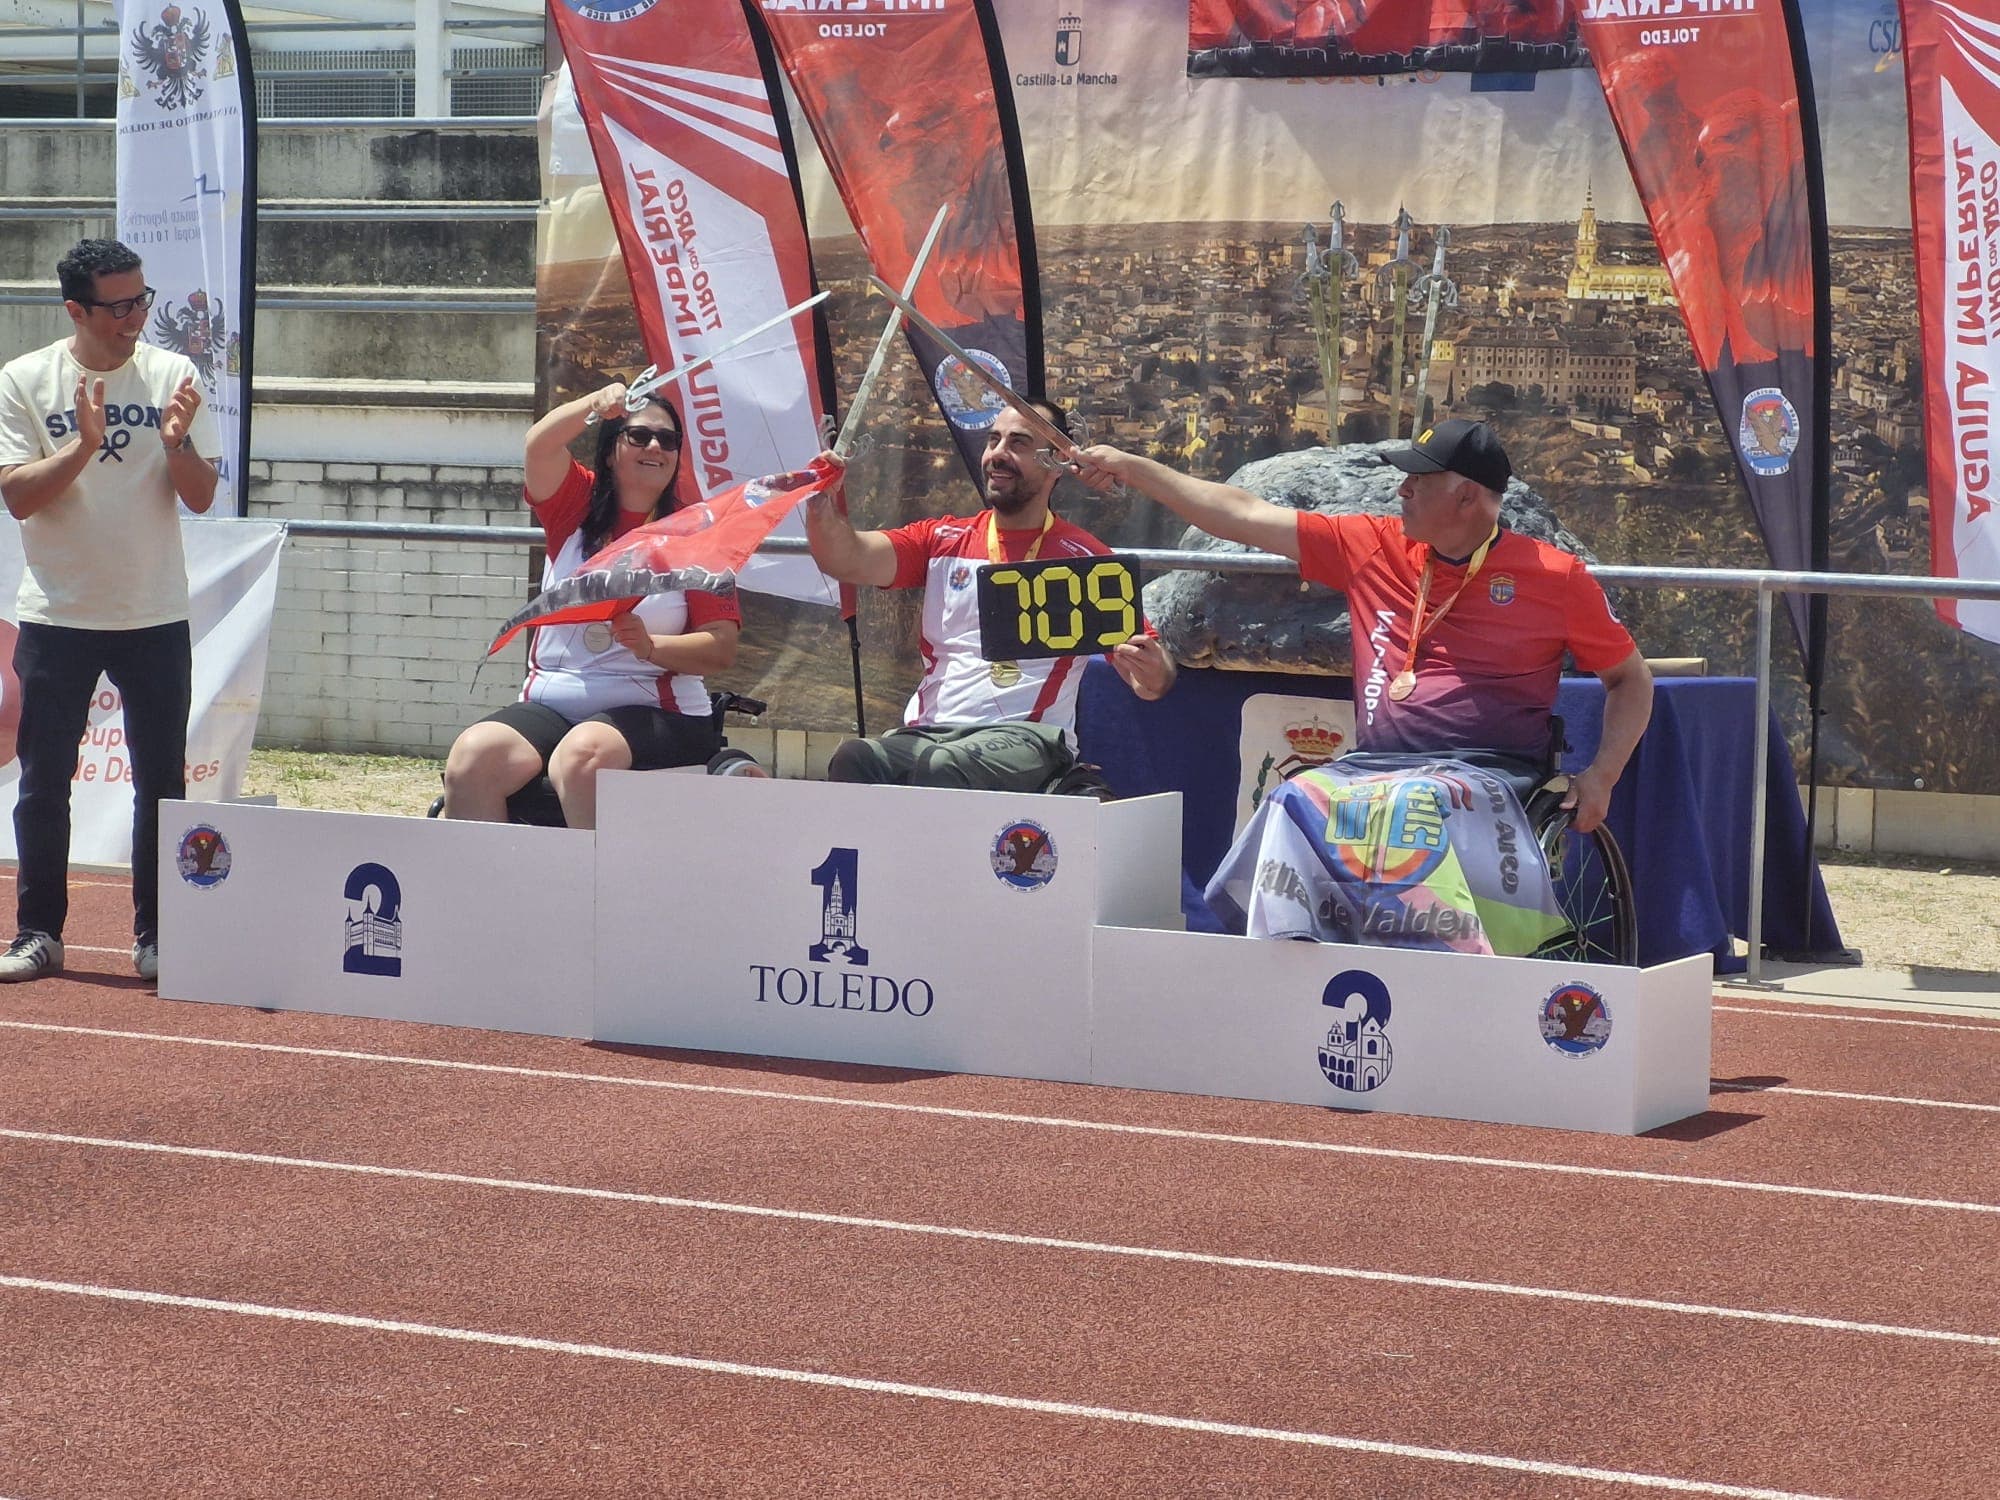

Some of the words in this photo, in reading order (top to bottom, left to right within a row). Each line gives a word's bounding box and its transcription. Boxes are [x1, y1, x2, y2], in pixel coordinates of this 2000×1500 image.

[1076, 72, 1118, 85] Mancha
[990, 562, 1136, 650] 709
[343, 862, 402, 977] 2
[808, 847, 869, 966] 1
[750, 965, 934, 1017] TOLEDO
[1318, 969, 1392, 1093] 3
